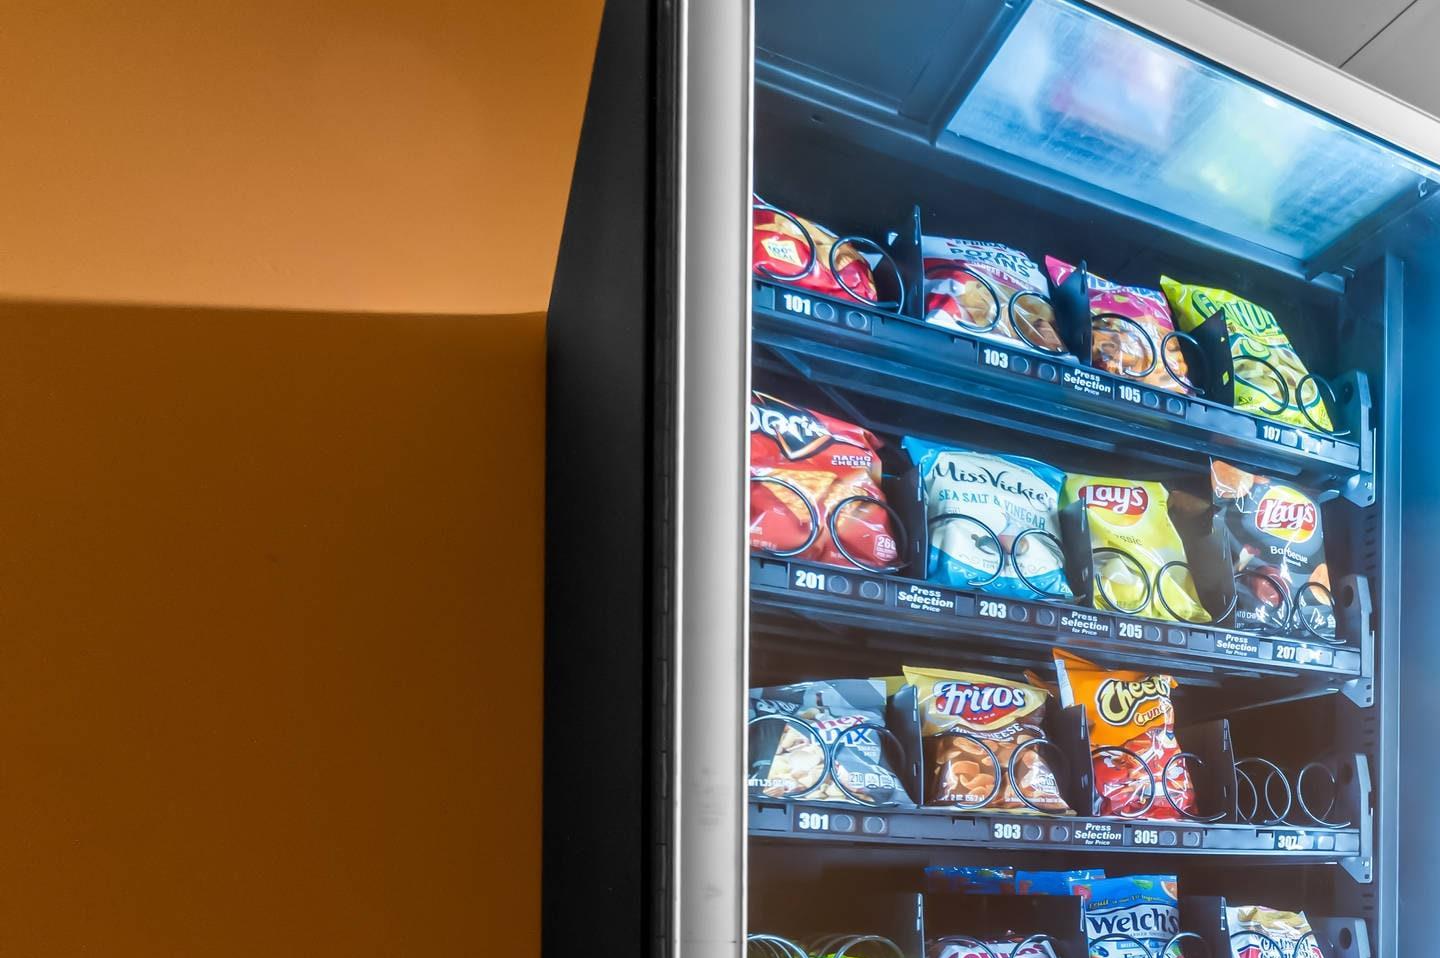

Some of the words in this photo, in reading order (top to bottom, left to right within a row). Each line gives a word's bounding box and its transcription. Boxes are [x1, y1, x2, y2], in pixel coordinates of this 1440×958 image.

[784, 294, 811, 315] 101
[983, 349, 1008, 369] 103
[1063, 372, 1111, 394] Selection
[1074, 368, 1100, 382] Press
[1118, 384, 1141, 404] 105
[1262, 425, 1281, 441] 107
[933, 461, 987, 483] Miss
[1086, 485, 1145, 515] Lay's
[939, 489, 959, 501] SEA
[962, 493, 989, 504] SALT
[993, 496, 1001, 506] &
[1004, 500, 1046, 529] VINEGAR
[1261, 499, 1313, 529] Lay's
[1271, 546, 1308, 563] Barbecue
[795, 571, 825, 590] 201
[910, 585, 941, 598] Press
[898, 591, 954, 609] Selection
[979, 601, 1007, 619] 203
[1071, 611, 1098, 622] Press
[1061, 617, 1108, 631] Selection
[1119, 623, 1142, 639] 205
[1216, 640, 1257, 653] Selection
[1225, 634, 1248, 643] Press
[1276, 645, 1295, 660] 207
[933, 682, 1025, 715] Fritos
[799, 813, 829, 829] 301
[1085, 823, 1111, 831] Press
[994, 824, 1020, 839] 303
[1074, 830, 1121, 841] Selection
[1135, 830, 1158, 845] 305
[1087, 908, 1178, 935] Welch's
